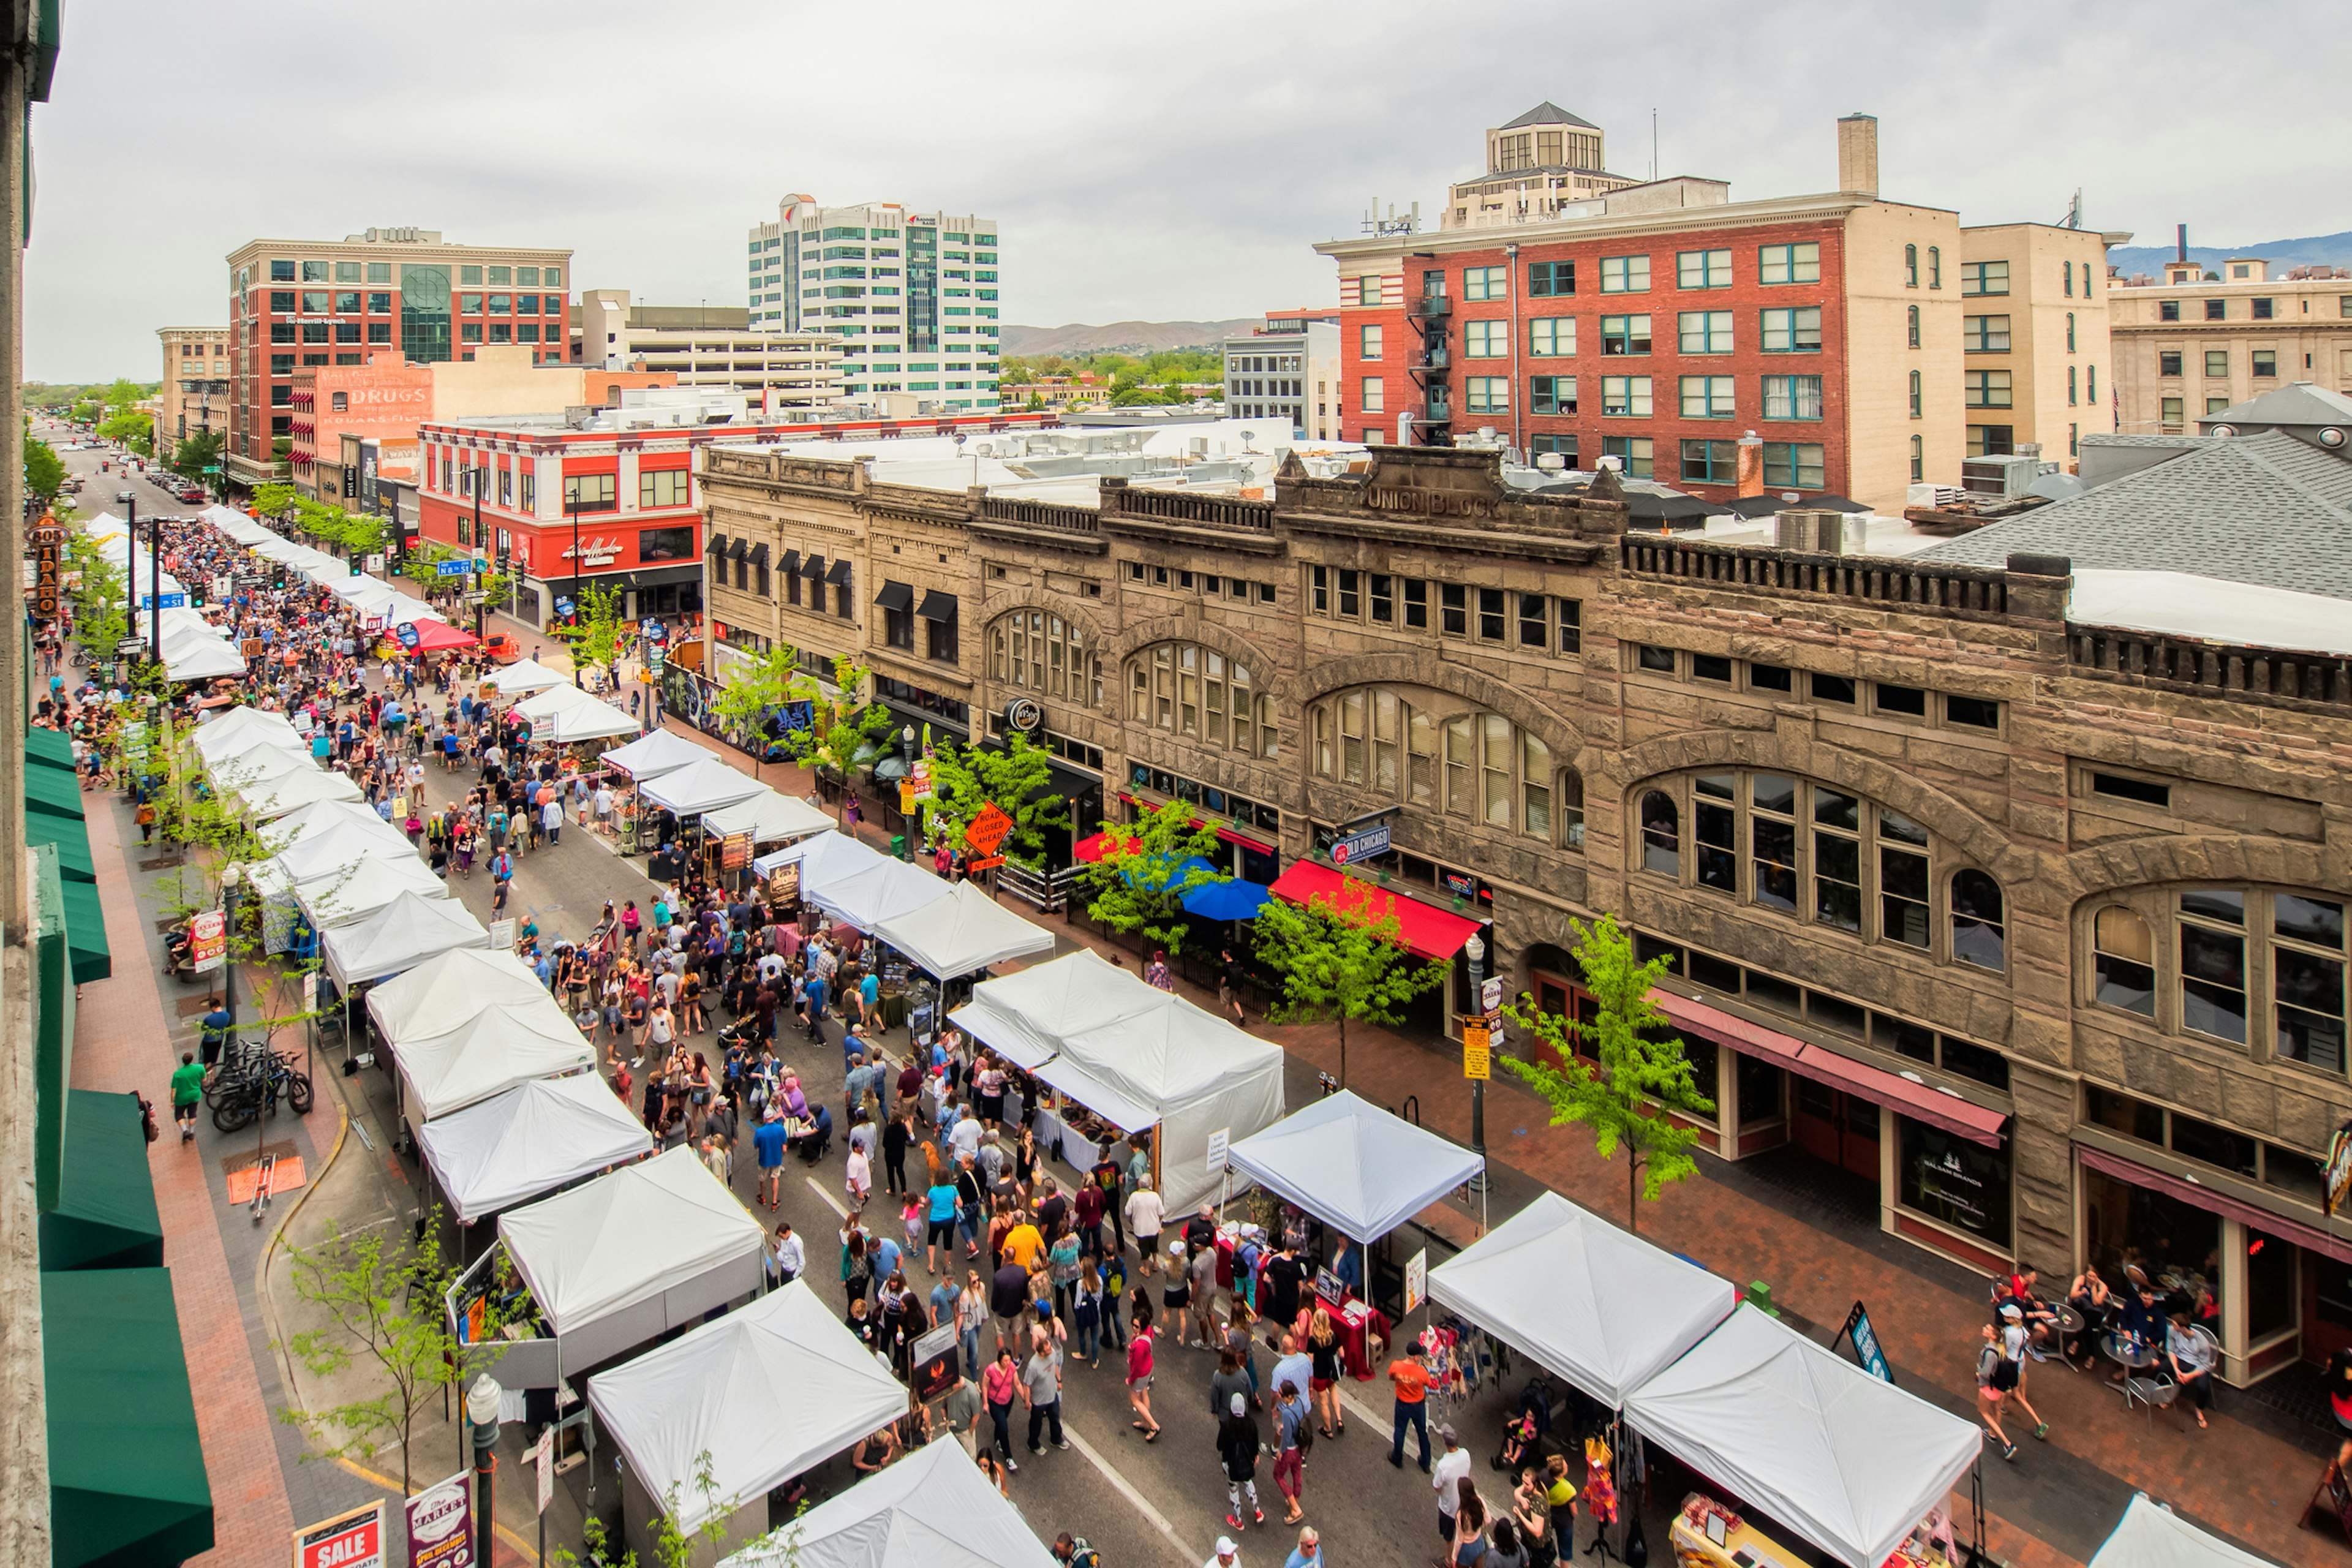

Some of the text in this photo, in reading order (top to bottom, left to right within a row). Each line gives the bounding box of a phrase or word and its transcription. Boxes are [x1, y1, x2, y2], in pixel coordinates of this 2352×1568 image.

[352, 389, 426, 404] DRUGS
[1368, 486, 1500, 518] UNION BLOCK
[39, 547, 56, 612] IDAHO
[975, 821, 1003, 834] CLOSED
[980, 811, 1000, 822] ROAD
[978, 832, 1002, 844] AHEAD
[1348, 830, 1388, 856] OLD CHICAGO
[1923, 1159, 1982, 1187] BALSAM BRANDS
[412, 1495, 466, 1529] MARKET
[431, 1499, 447, 1510] The
[318, 1531, 366, 1568] SALE
